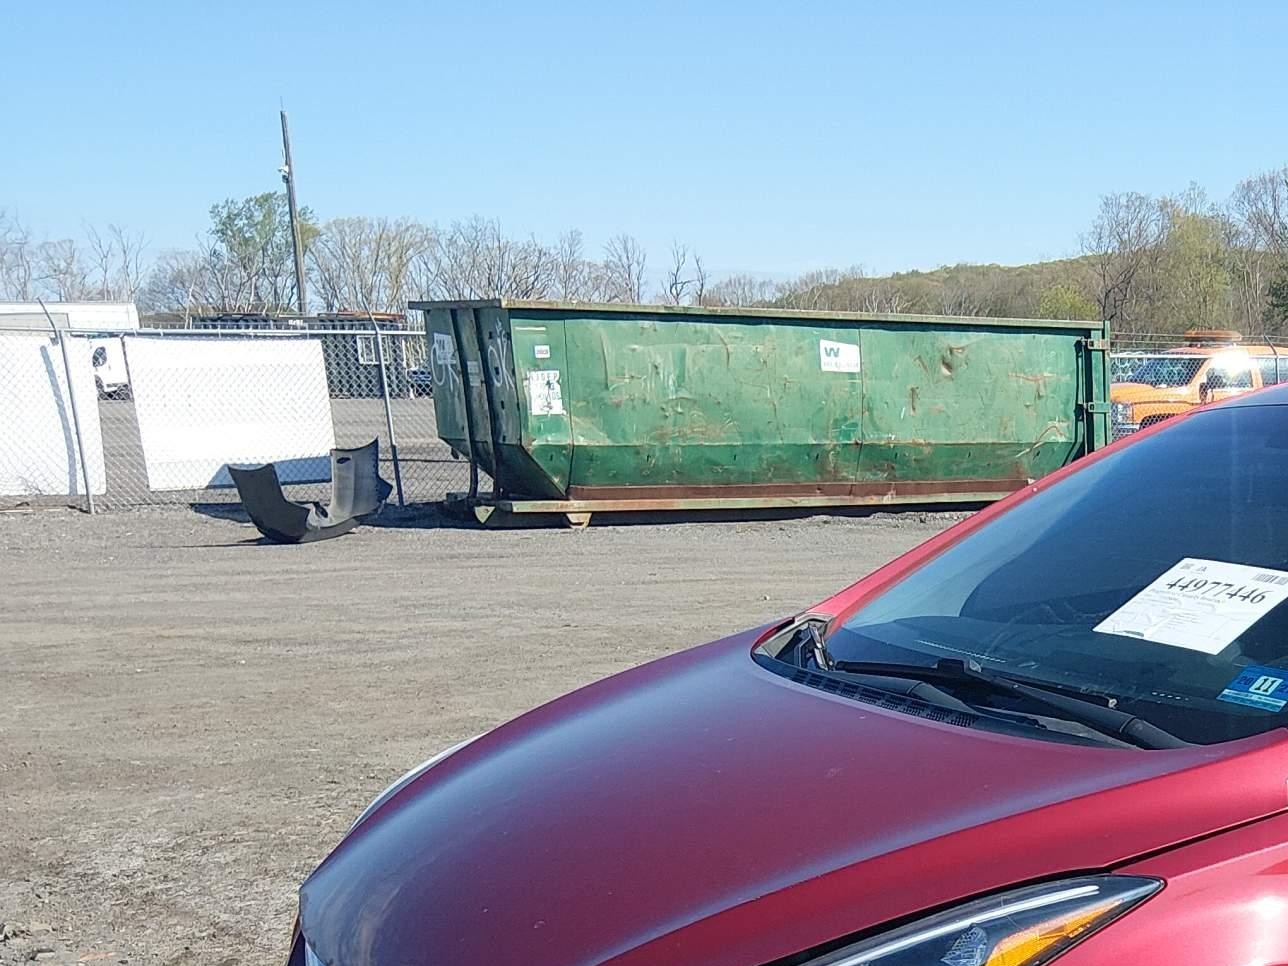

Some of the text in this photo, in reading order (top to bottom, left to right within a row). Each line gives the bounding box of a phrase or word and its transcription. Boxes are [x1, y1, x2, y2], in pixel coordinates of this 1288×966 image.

[487, 337, 516, 392] OK
[1165, 576, 1275, 604] 44977446
[1254, 677, 1277, 693] 11
